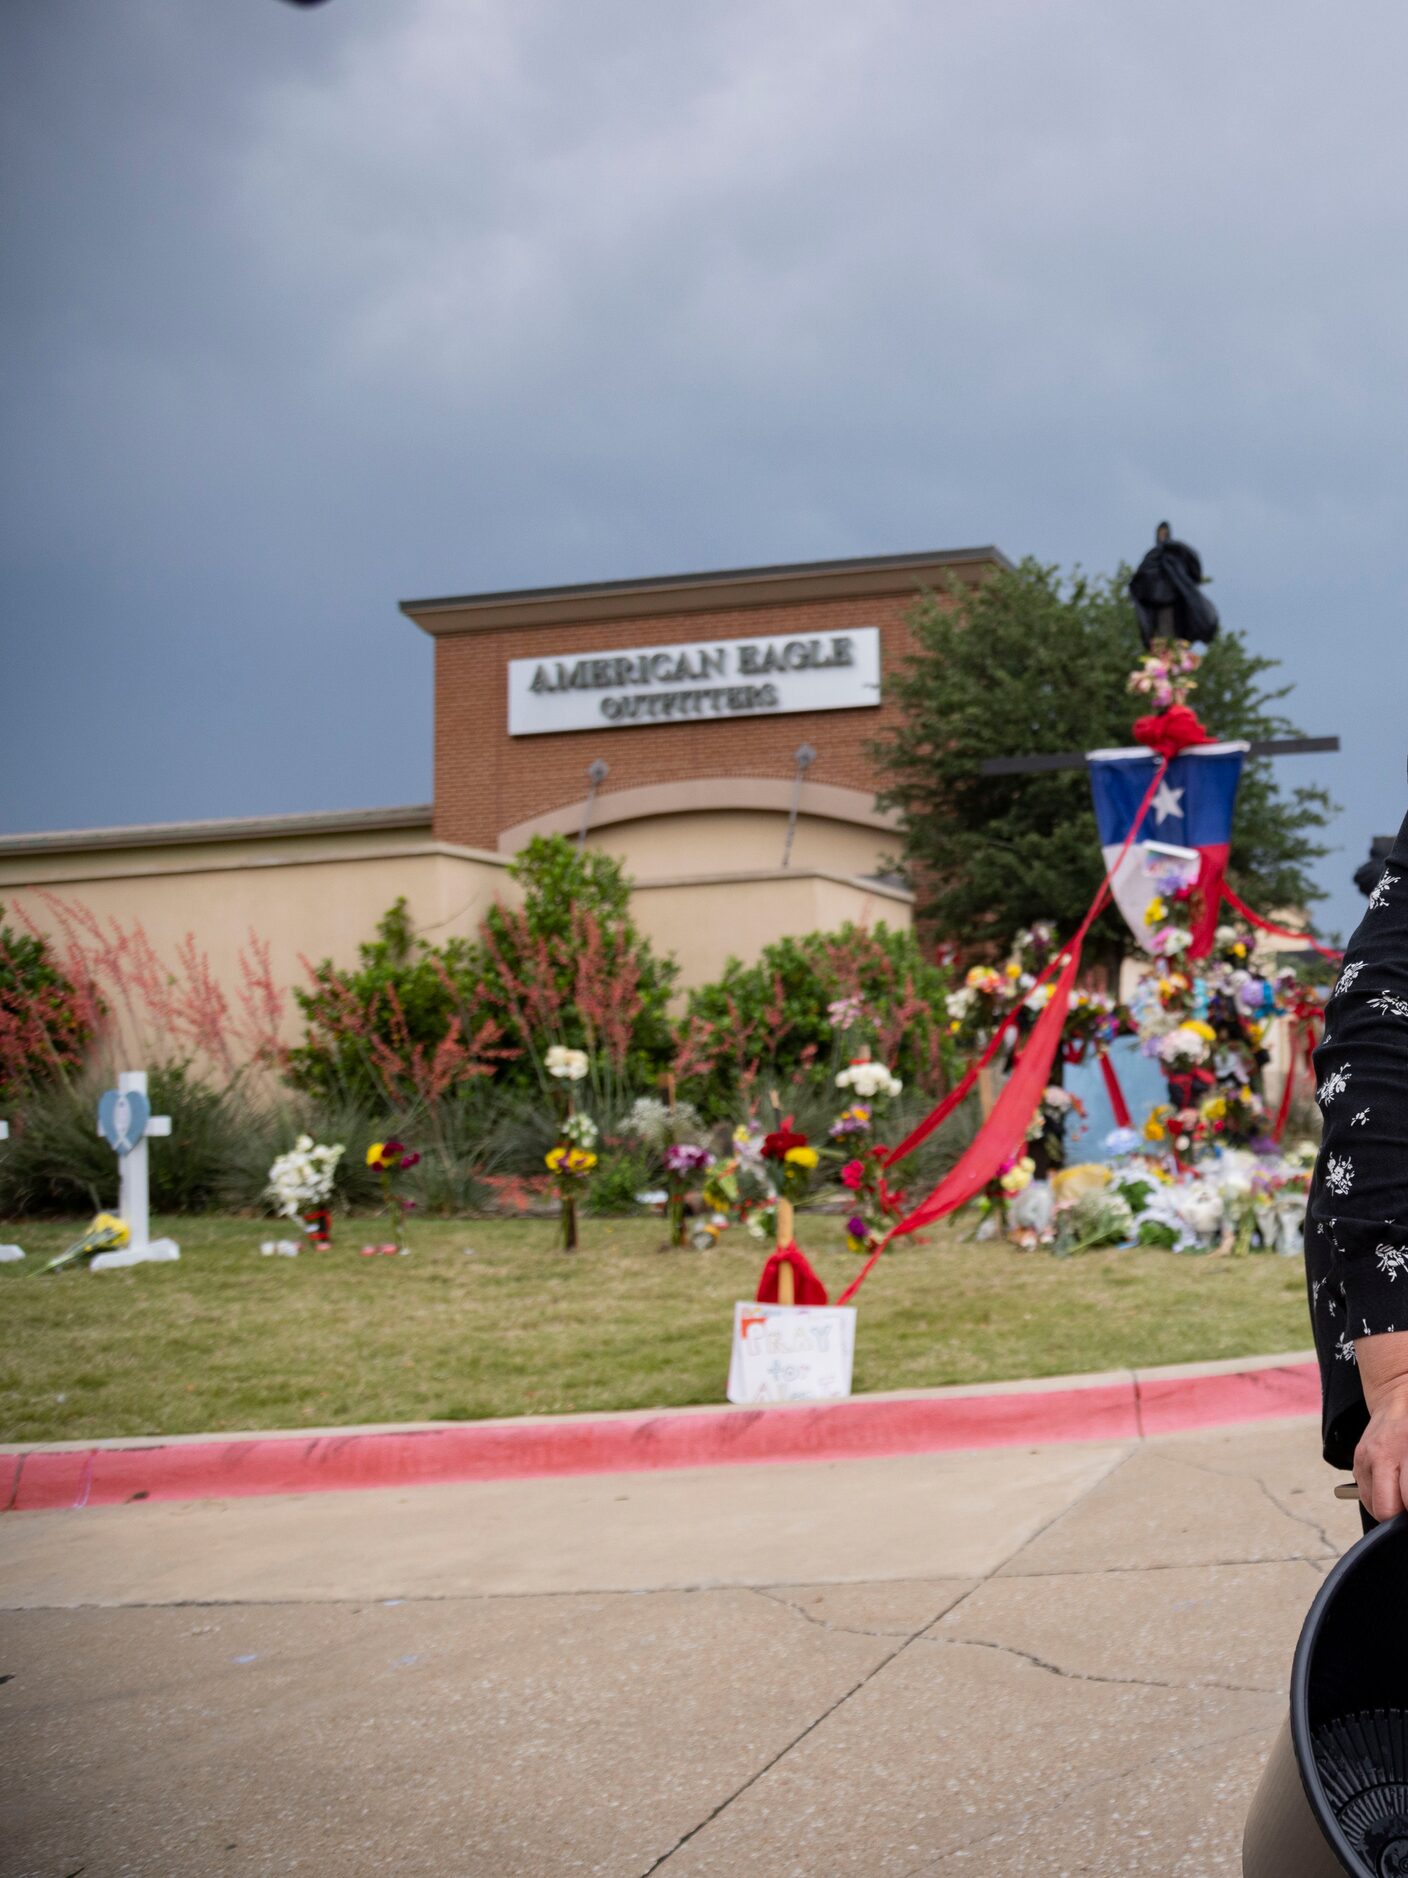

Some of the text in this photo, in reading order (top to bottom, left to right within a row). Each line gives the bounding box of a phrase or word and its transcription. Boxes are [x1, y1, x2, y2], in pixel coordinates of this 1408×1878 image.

[529, 636, 853, 693] AMERICAN EAGLE
[600, 684, 777, 720] OUTFITTERS
